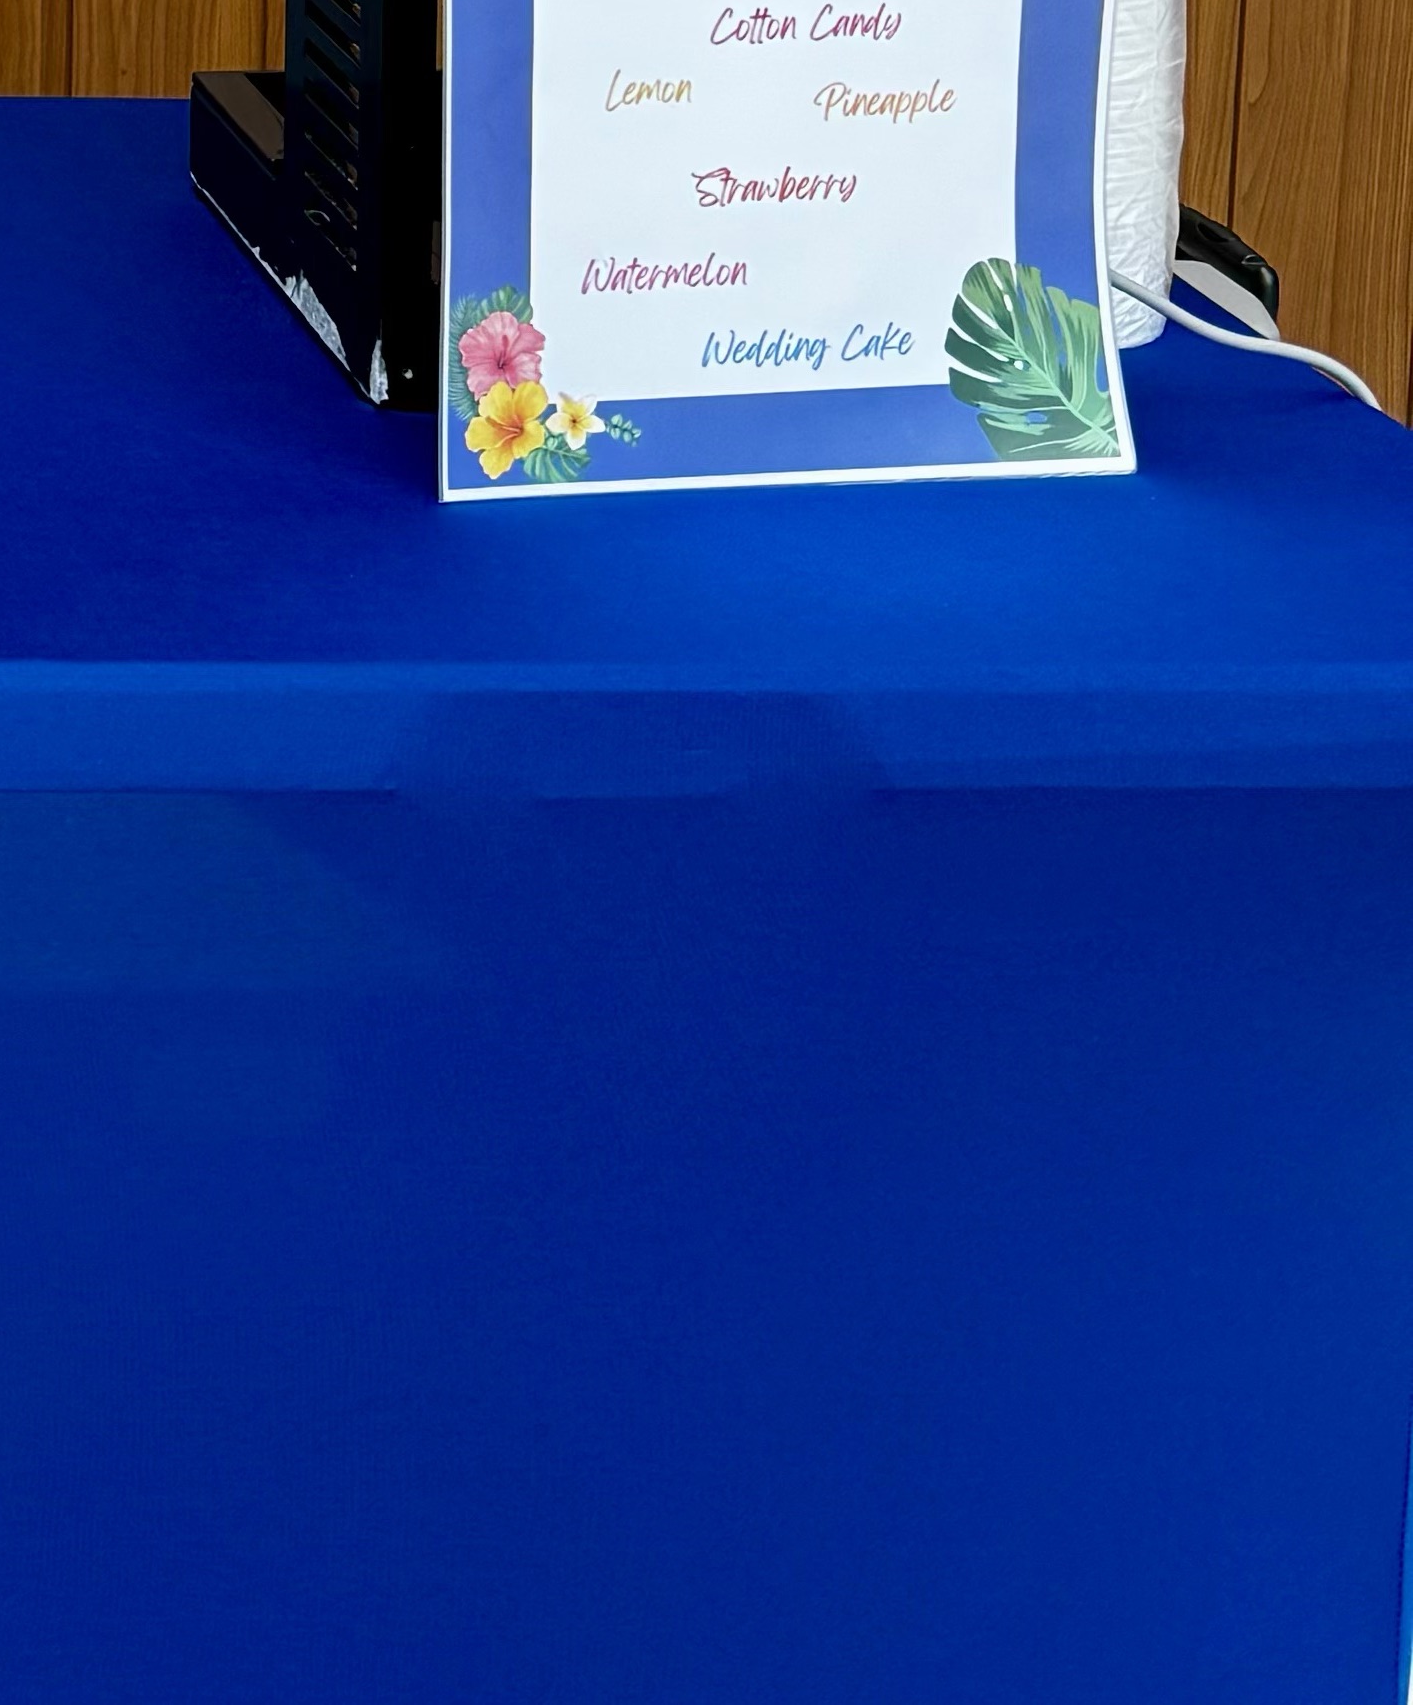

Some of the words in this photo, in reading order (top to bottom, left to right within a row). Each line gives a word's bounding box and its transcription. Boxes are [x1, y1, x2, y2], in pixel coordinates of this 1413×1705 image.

[710, 7, 797, 45] Cotton
[810, 3, 902, 40] Candy
[605, 69, 692, 112] Lemon
[814, 78, 957, 123] Pineapple
[691, 166, 857, 207] Strawberry
[580, 252, 748, 295] Watermelon
[701, 329, 831, 370] Wedding
[840, 322, 915, 361] Cake
